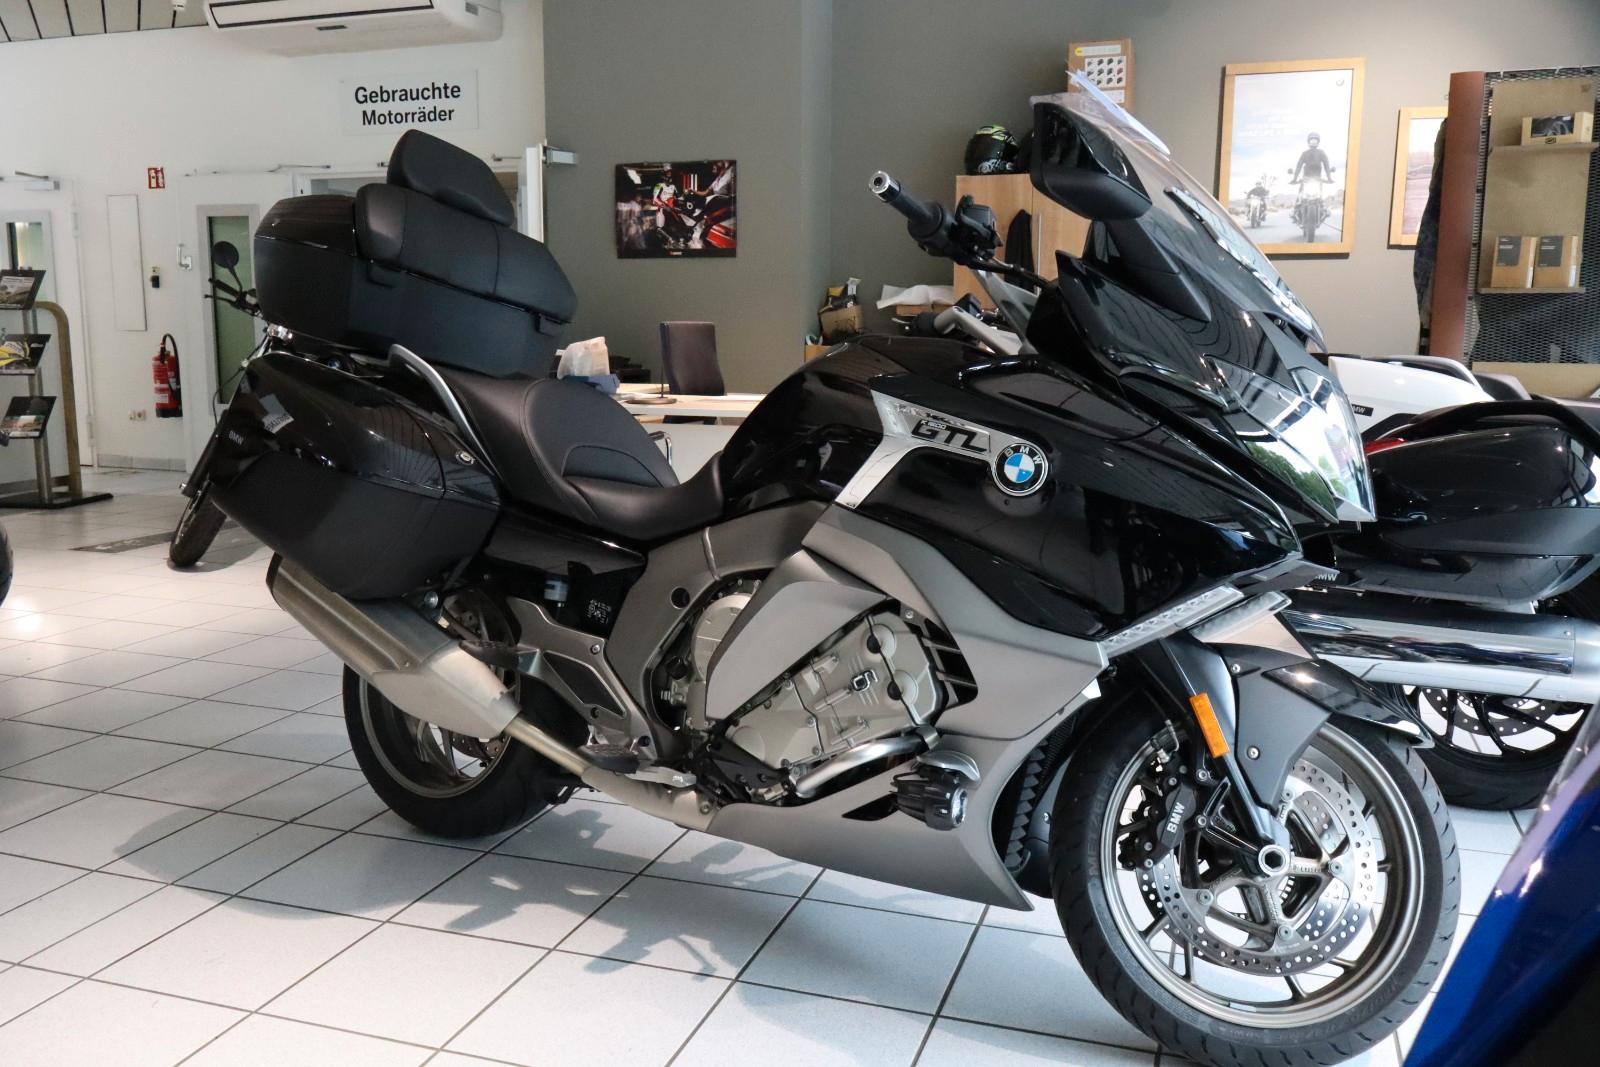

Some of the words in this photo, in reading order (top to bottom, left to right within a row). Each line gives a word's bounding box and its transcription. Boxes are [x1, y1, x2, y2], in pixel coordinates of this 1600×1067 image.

[354, 82, 461, 104] Gebrauchte
[361, 105, 455, 126] Motorräder
[911, 419, 988, 453] GTL
[1004, 445, 1043, 465] BMW
[1316, 573, 1337, 582] MW
[1166, 801, 1186, 834] BMW
